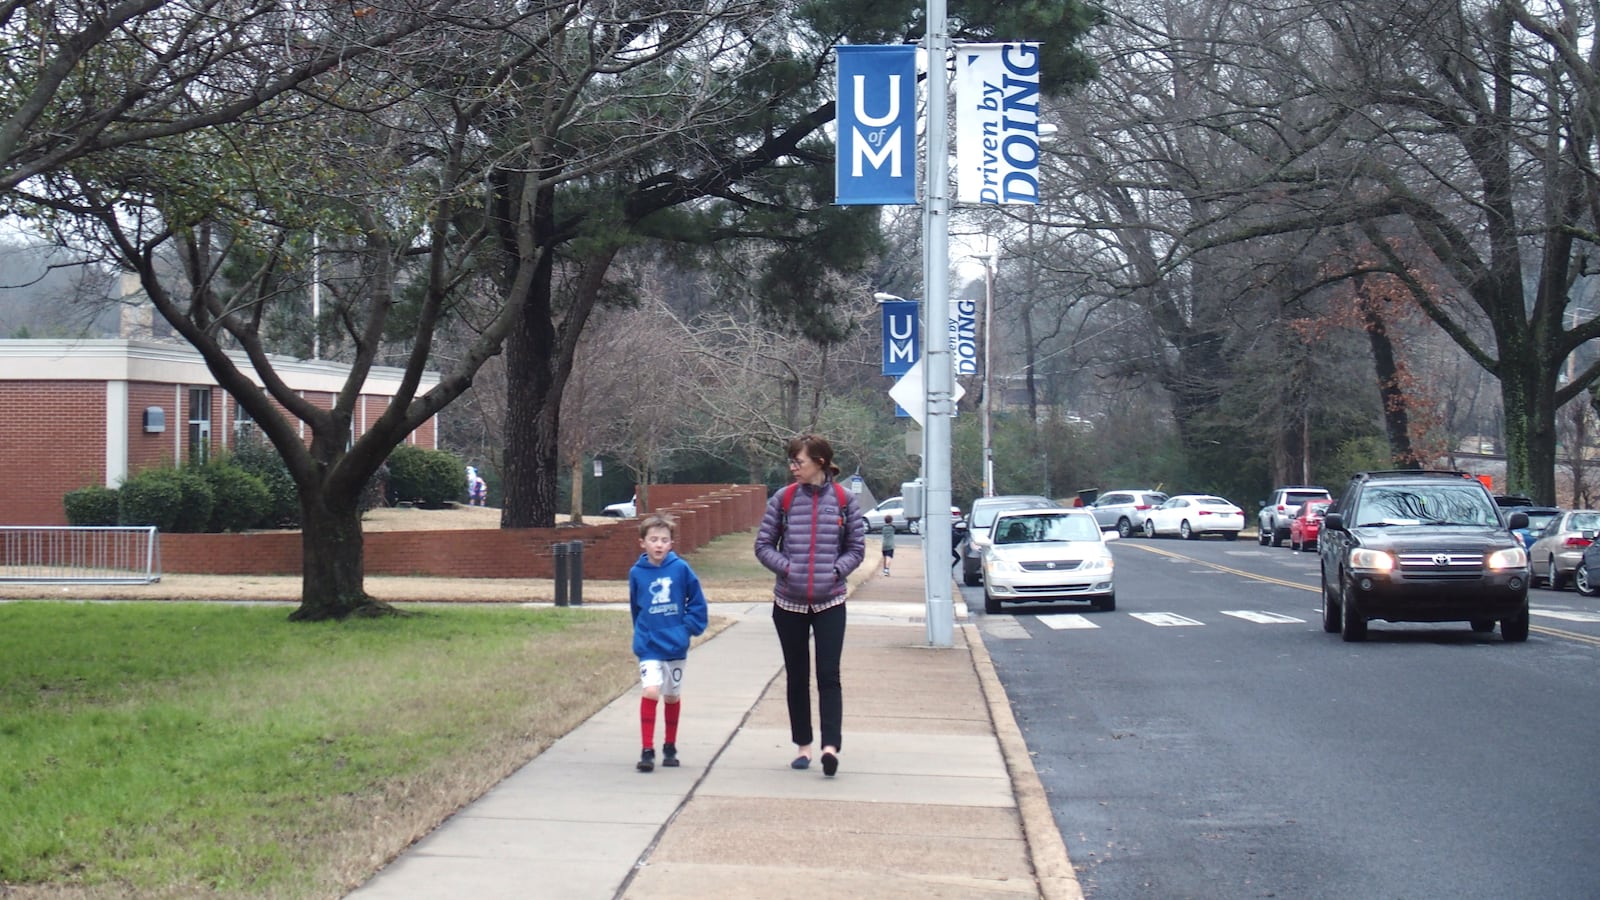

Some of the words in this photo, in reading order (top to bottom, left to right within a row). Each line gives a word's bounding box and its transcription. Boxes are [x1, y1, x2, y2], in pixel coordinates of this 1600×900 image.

[853, 75, 901, 127] U
[977, 81, 1004, 112] by
[868, 128, 887, 147] of
[1001, 43, 1040, 205] DOING
[852, 125, 902, 177] M
[977, 121, 999, 204] Driven
[889, 315, 912, 339] U
[889, 338, 914, 363] M
[958, 300, 976, 374] DOING
